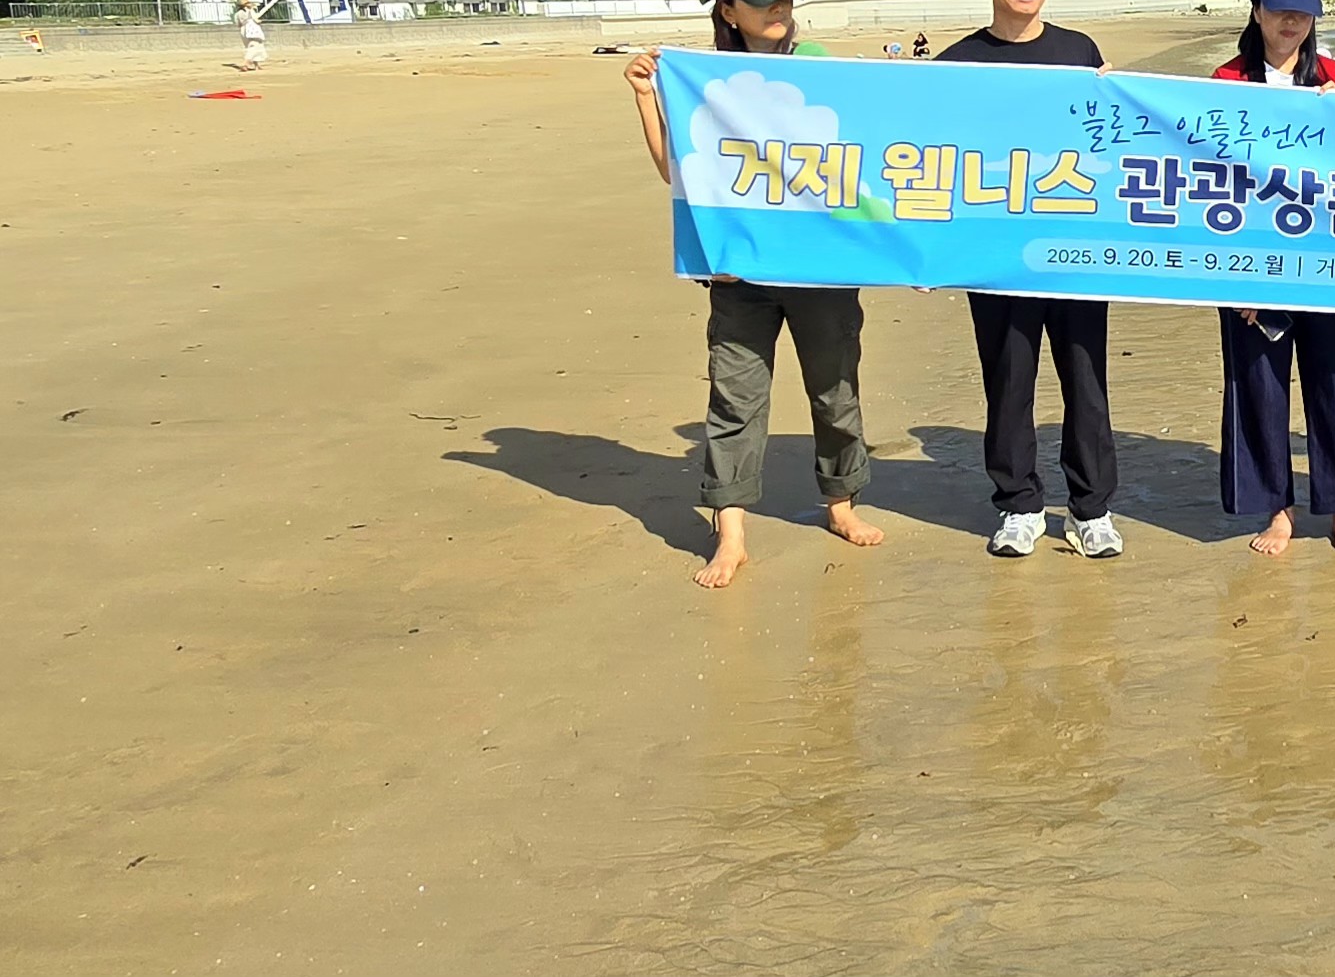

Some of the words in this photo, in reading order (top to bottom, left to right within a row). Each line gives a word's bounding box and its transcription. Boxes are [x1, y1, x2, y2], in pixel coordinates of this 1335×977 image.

[1176, 109, 1326, 160] 인플루언서
[720, 138, 863, 209] 거제
[881, 142, 1098, 222] 웰니스
[1046, 248, 1098, 266] 2025.
[1264, 254, 1285, 277] 월
